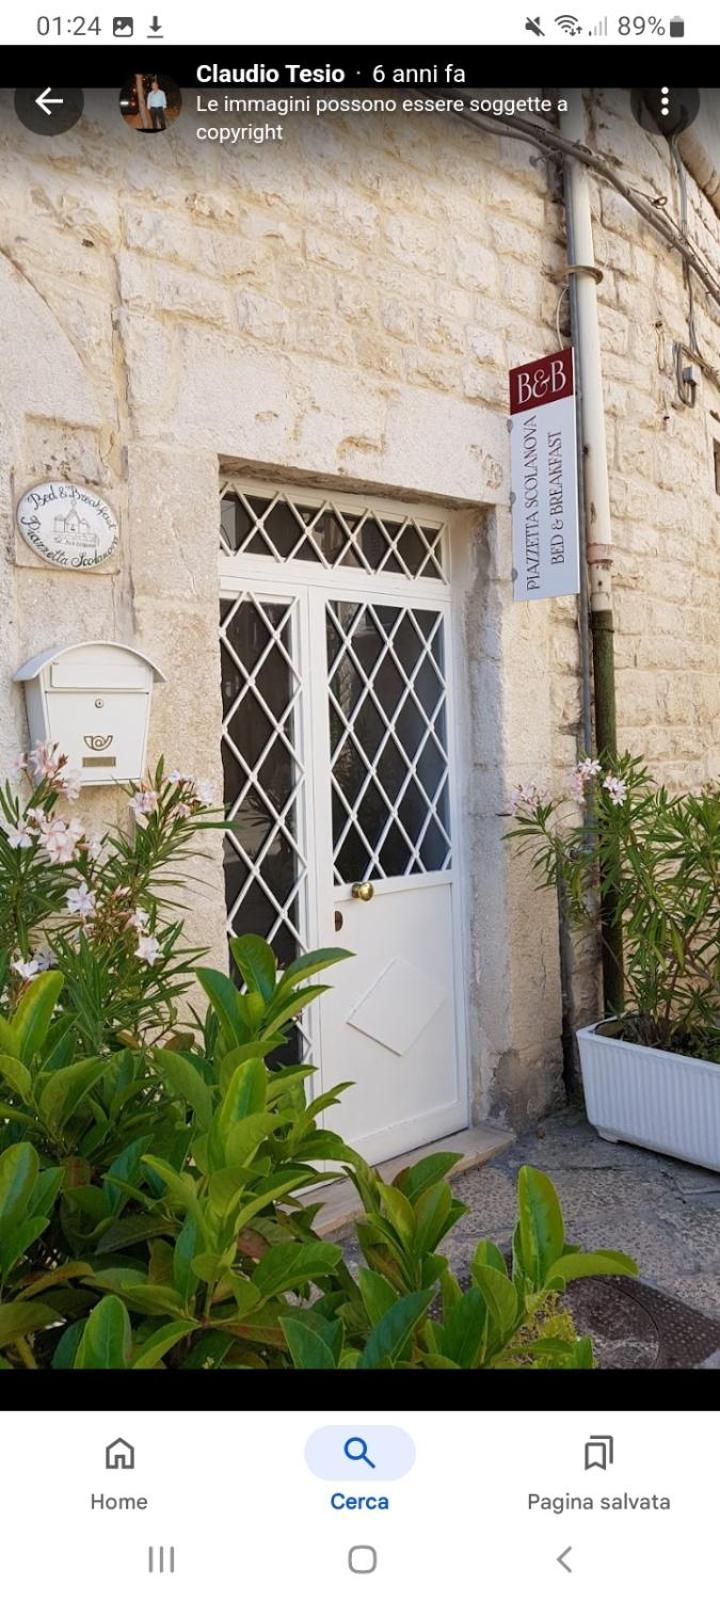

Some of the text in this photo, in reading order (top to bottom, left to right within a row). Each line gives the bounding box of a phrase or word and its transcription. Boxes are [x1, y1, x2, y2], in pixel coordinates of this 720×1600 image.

[517, 359, 567, 405] B&B
[524, 415, 540, 592] PIAZZETTA SCOLANOVA
[548, 430, 565, 566] BED & BREAKFAST
